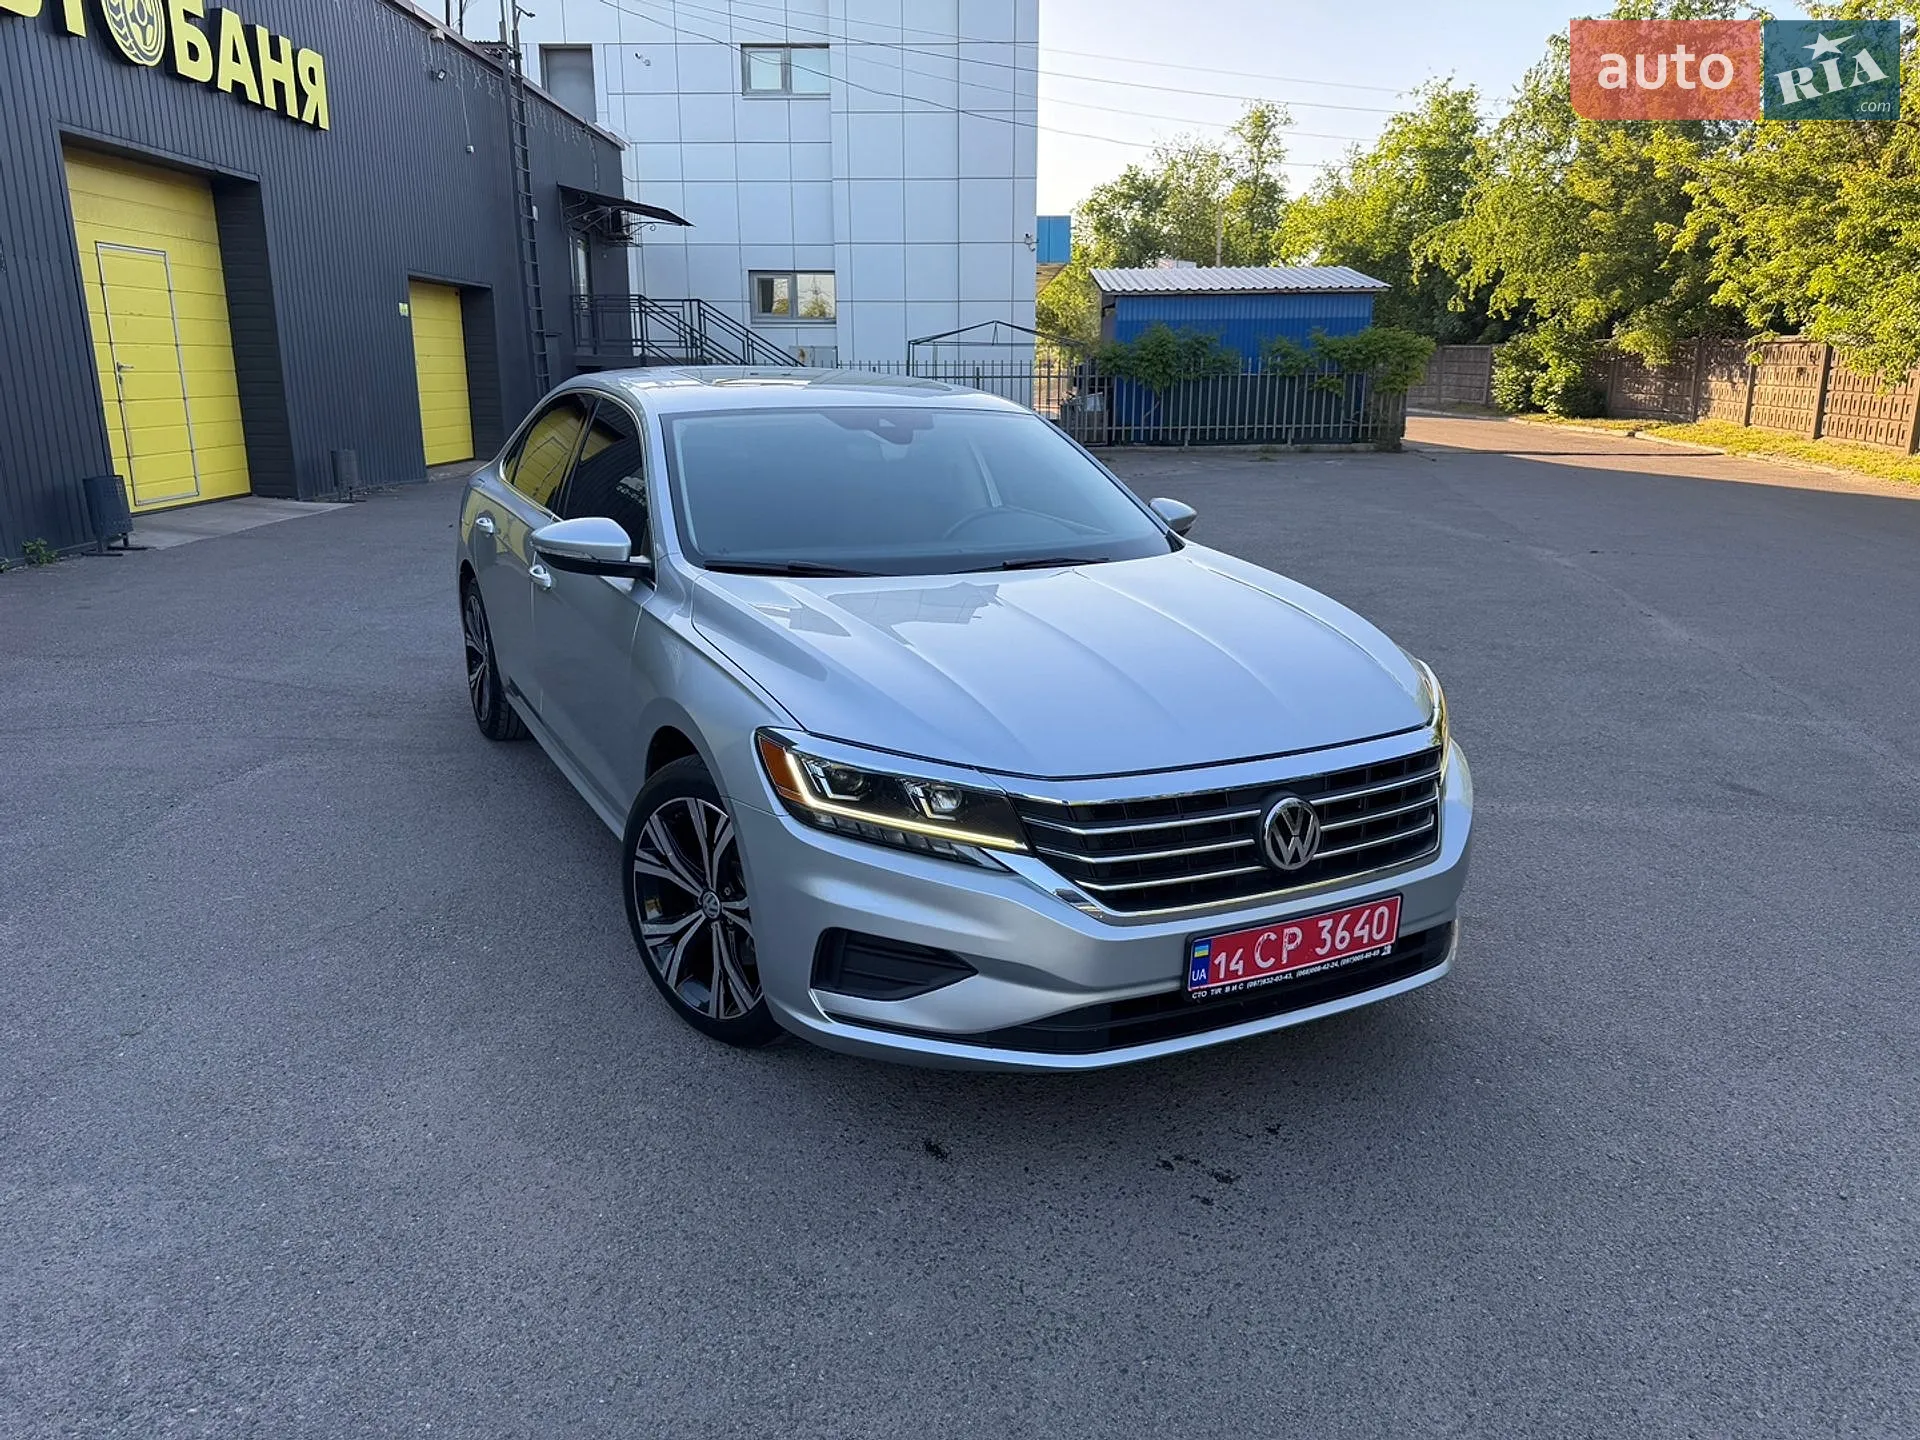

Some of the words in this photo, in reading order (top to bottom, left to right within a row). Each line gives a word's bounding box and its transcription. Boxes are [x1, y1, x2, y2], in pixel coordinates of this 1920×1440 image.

[1213, 947, 1244, 979] 14
[1254, 926, 1303, 969] CP
[1314, 905, 1390, 956] 3640
[1191, 967, 1207, 982] UA
